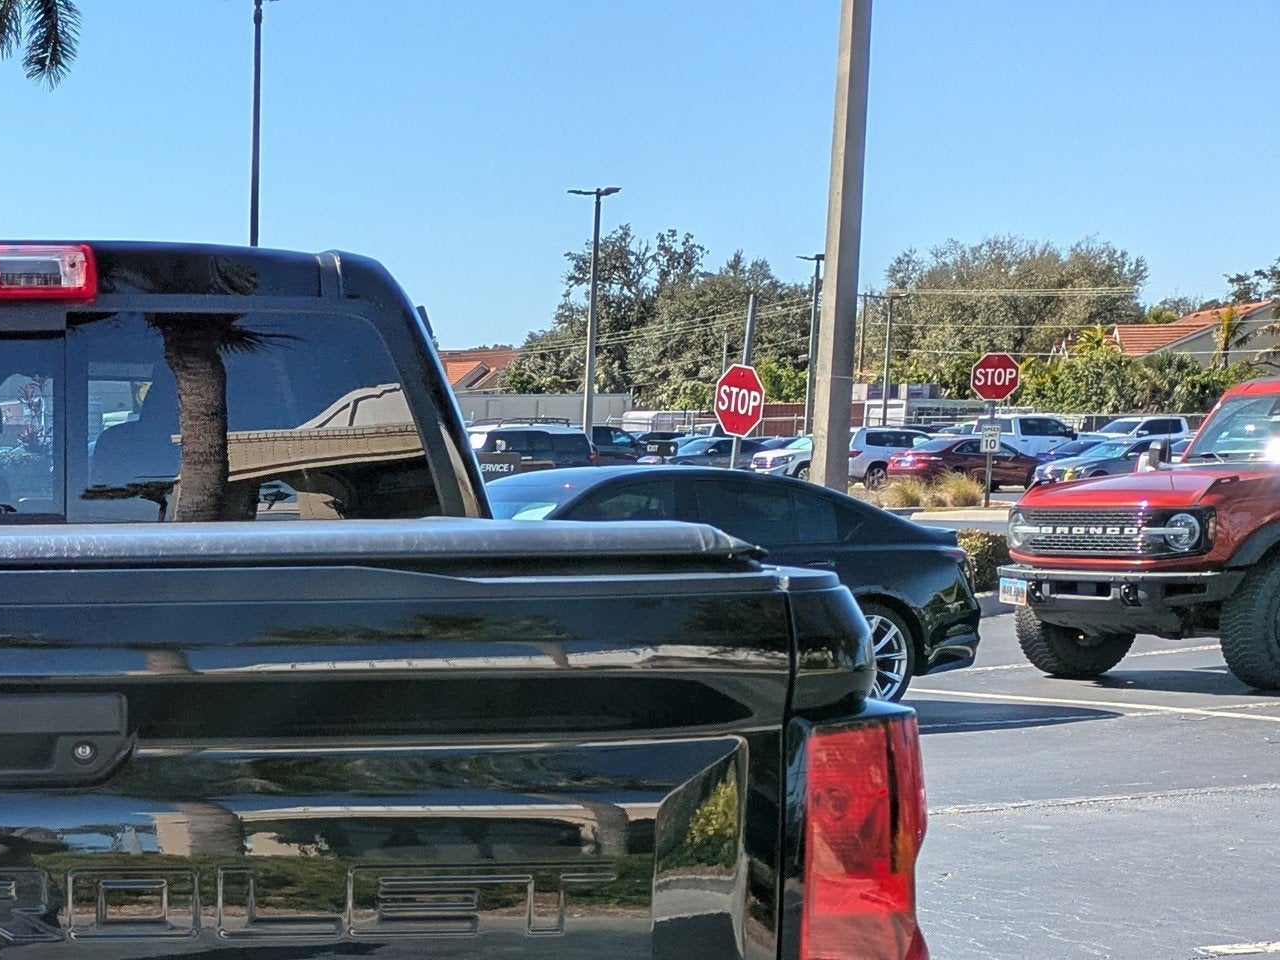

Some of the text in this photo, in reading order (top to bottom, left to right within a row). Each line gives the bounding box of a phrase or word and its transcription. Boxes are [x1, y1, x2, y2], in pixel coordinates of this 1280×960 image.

[974, 367, 1016, 386] STOP
[718, 384, 761, 417] STOP
[646, 444, 659, 452] EXIT
[984, 438, 997, 450] 10
[479, 463, 510, 472] ERVICE
[1040, 526, 1139, 535] BRONCO
